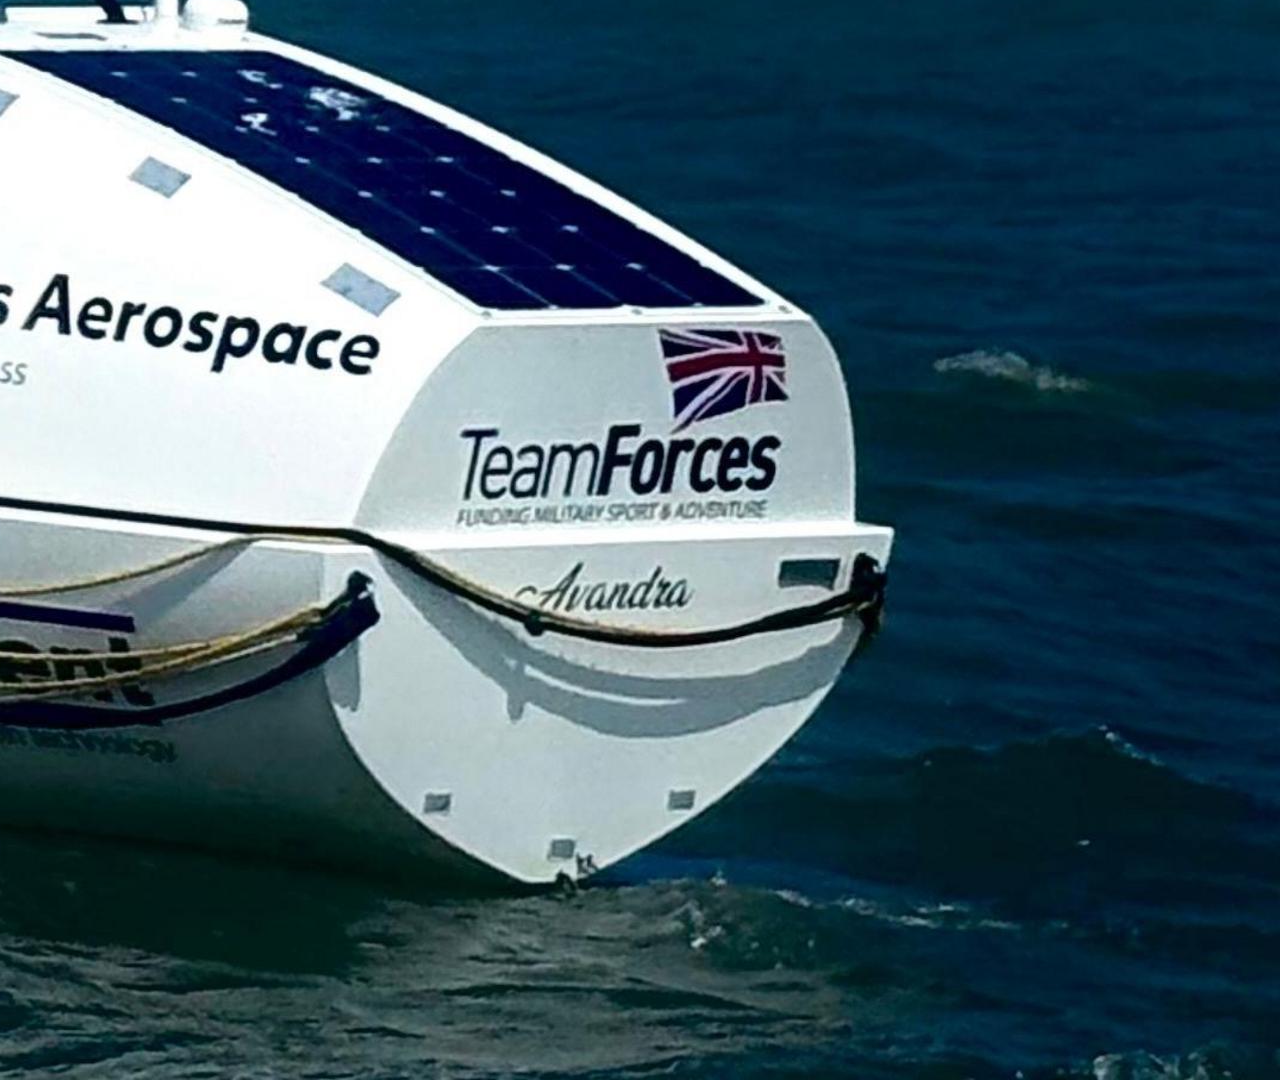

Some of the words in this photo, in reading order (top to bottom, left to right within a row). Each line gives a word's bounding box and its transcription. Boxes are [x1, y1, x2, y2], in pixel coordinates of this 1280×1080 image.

[20, 273, 381, 376] Aerospace
[459, 424, 782, 501] TeamForces
[456, 505, 531, 528] FUNDING
[533, 503, 605, 525] MILITARY
[606, 502, 657, 522] SPORT
[674, 499, 769, 520] ADVENTURE
[515, 561, 696, 613] Avandra
